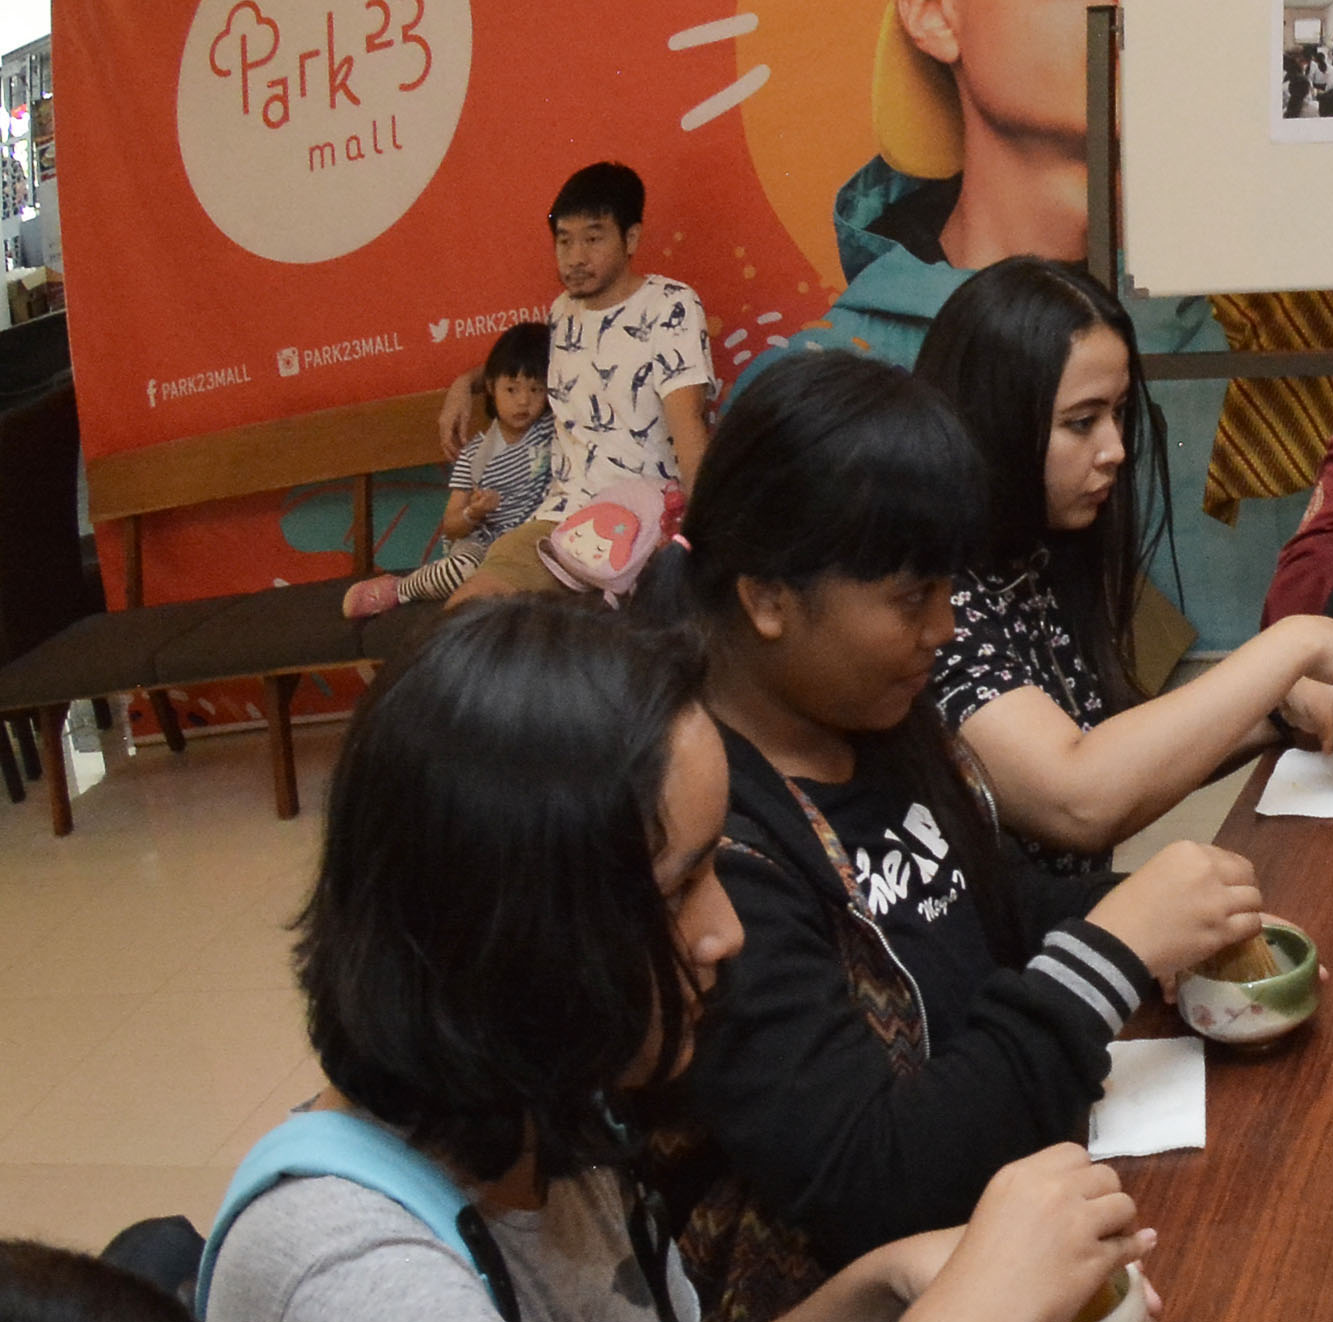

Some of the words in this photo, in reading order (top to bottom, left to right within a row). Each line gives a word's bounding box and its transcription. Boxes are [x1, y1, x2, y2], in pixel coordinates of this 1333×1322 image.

[308, 114, 404, 173] mall
[303, 332, 405, 369] PARK23MALL
[161, 363, 252, 402] PARK23MALL
